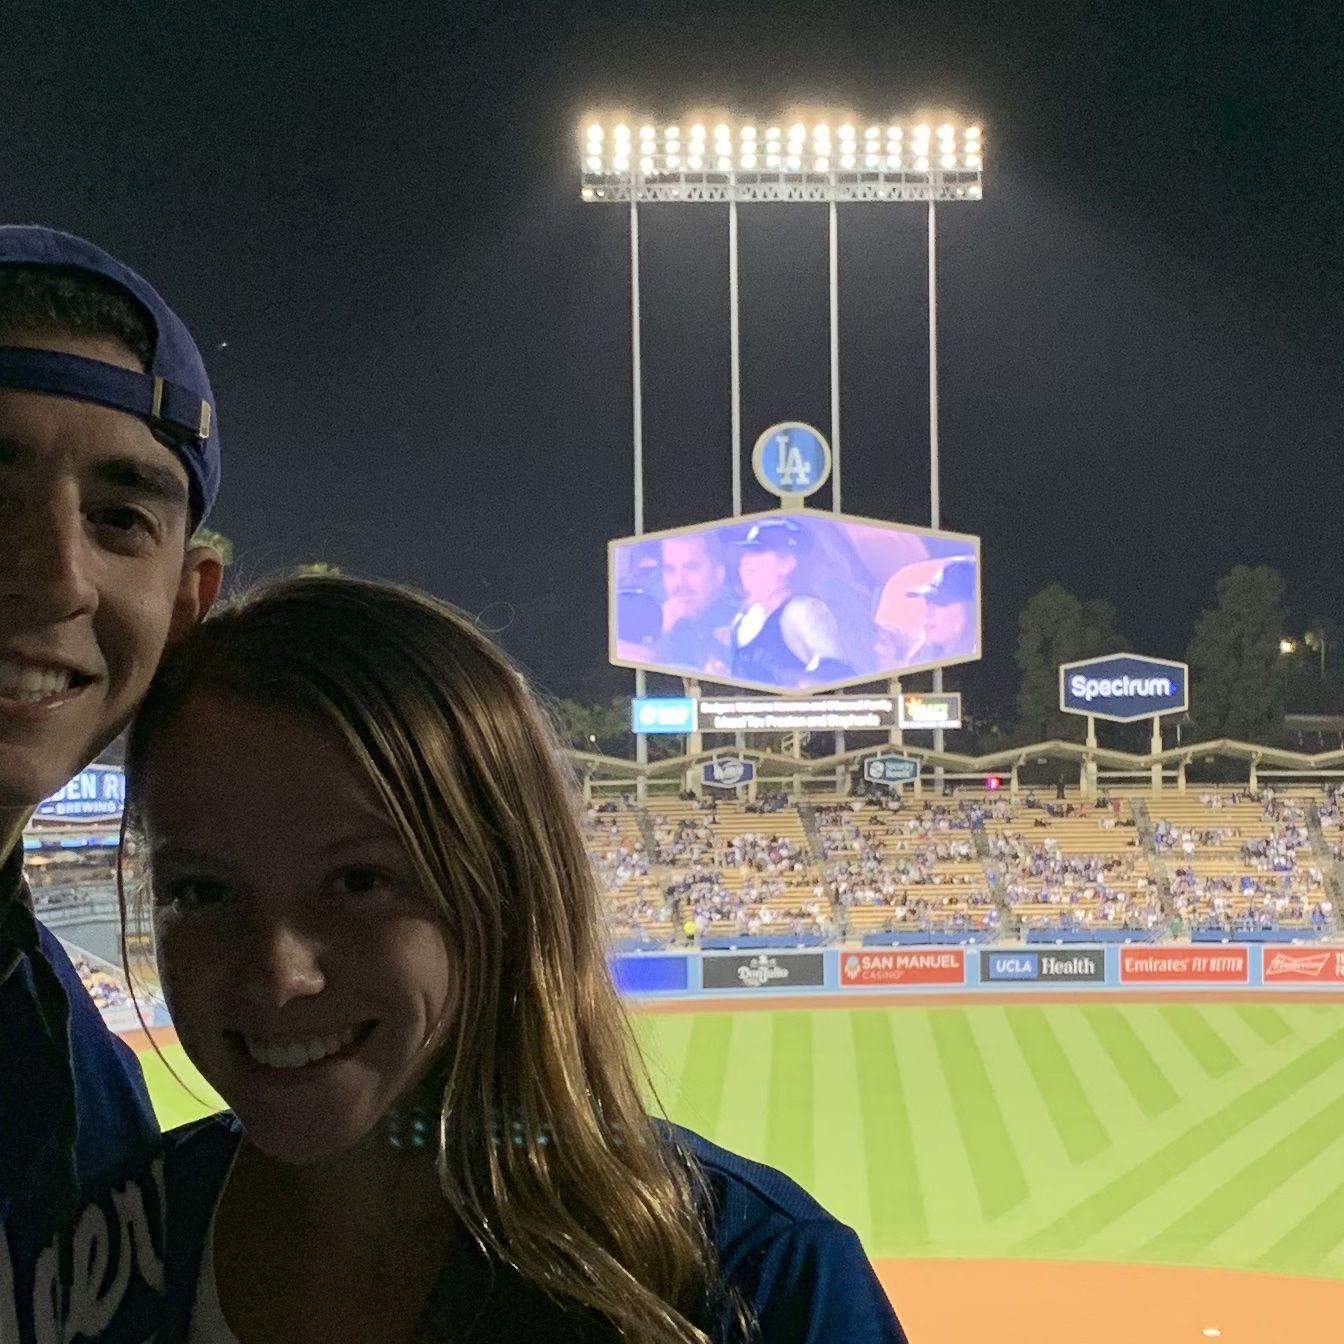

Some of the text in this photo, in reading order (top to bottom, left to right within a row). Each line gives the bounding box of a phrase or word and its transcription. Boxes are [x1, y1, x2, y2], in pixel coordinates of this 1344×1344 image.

[1071, 674, 1170, 701] Spectrum
[55, 800, 116, 815] BREWING
[861, 955, 959, 970] SAN MANUEL
[996, 958, 1096, 975] UCLA Health
[1124, 957, 1244, 973] Emirates FLY BETTER
